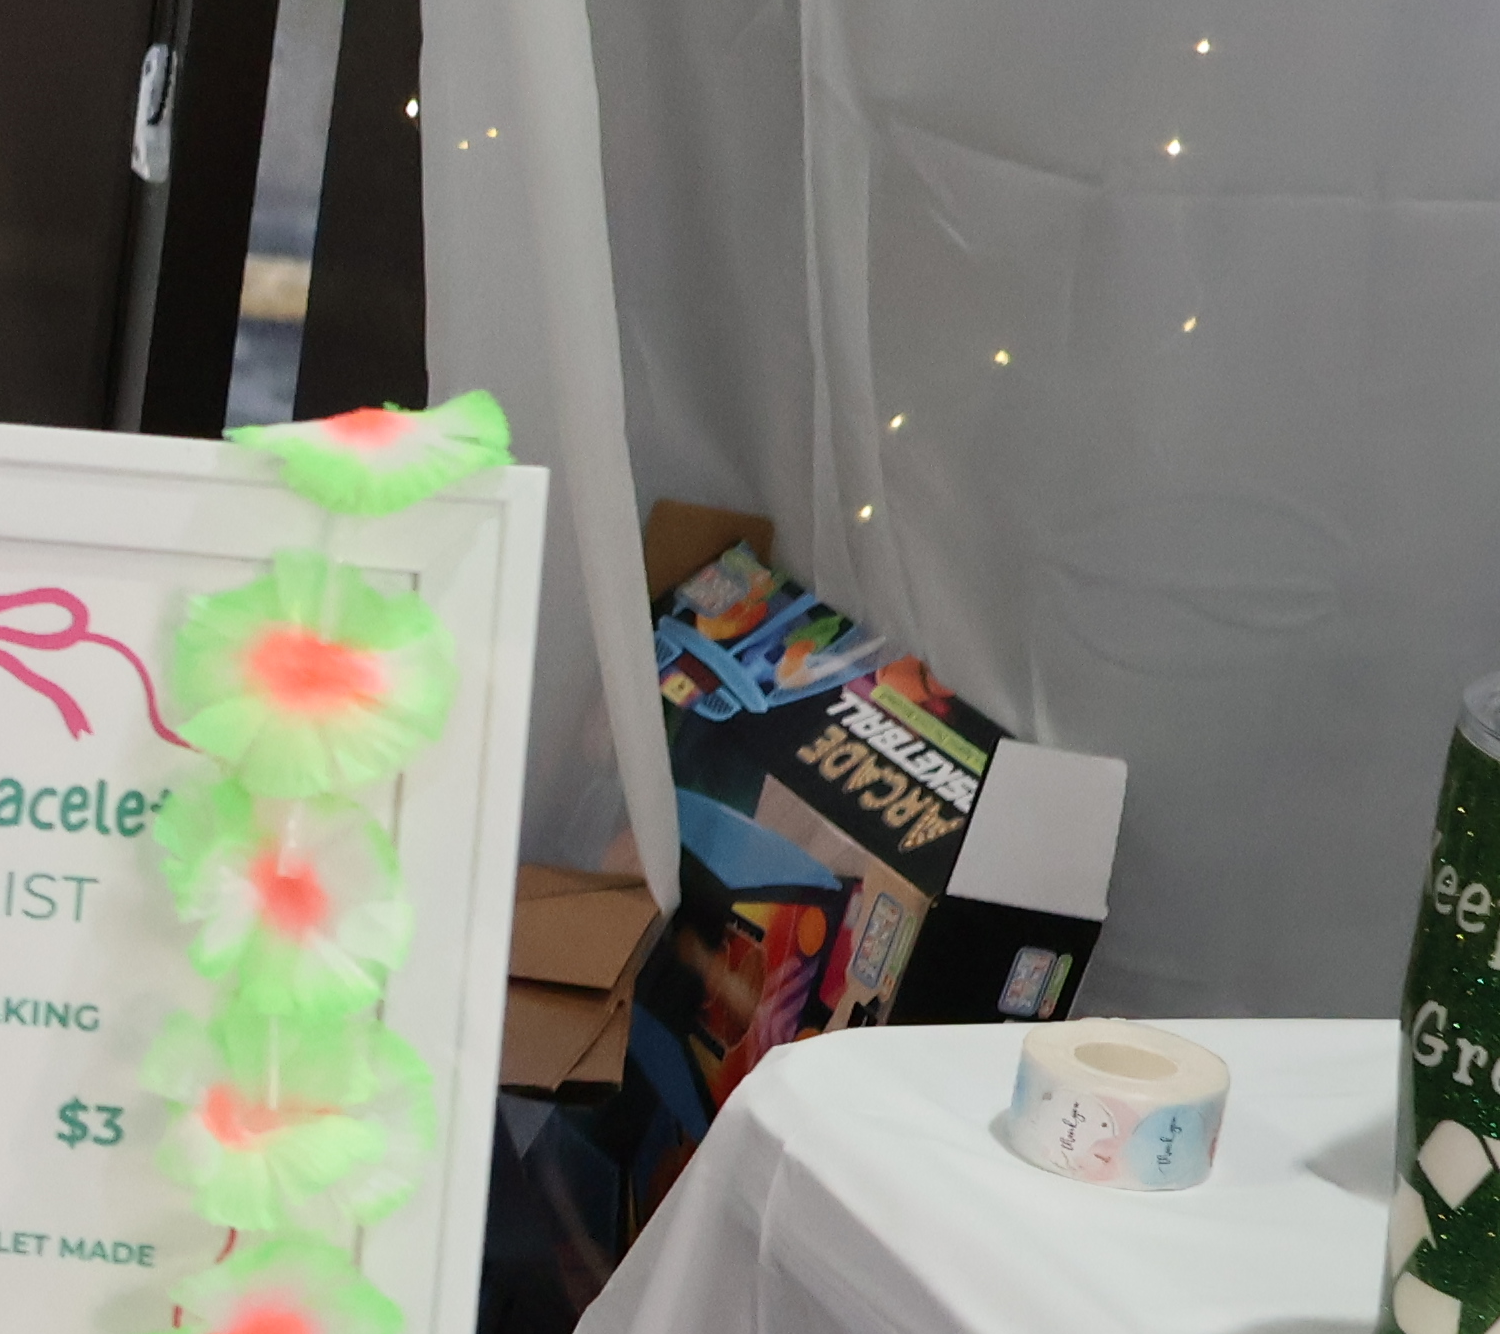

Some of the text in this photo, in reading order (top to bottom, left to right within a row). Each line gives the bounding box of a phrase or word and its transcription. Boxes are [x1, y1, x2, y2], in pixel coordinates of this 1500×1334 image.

[796, 723, 966, 852] ARCADE
[55, 1097, 125, 1148] $3
[58, 1237, 157, 1268] MADE
